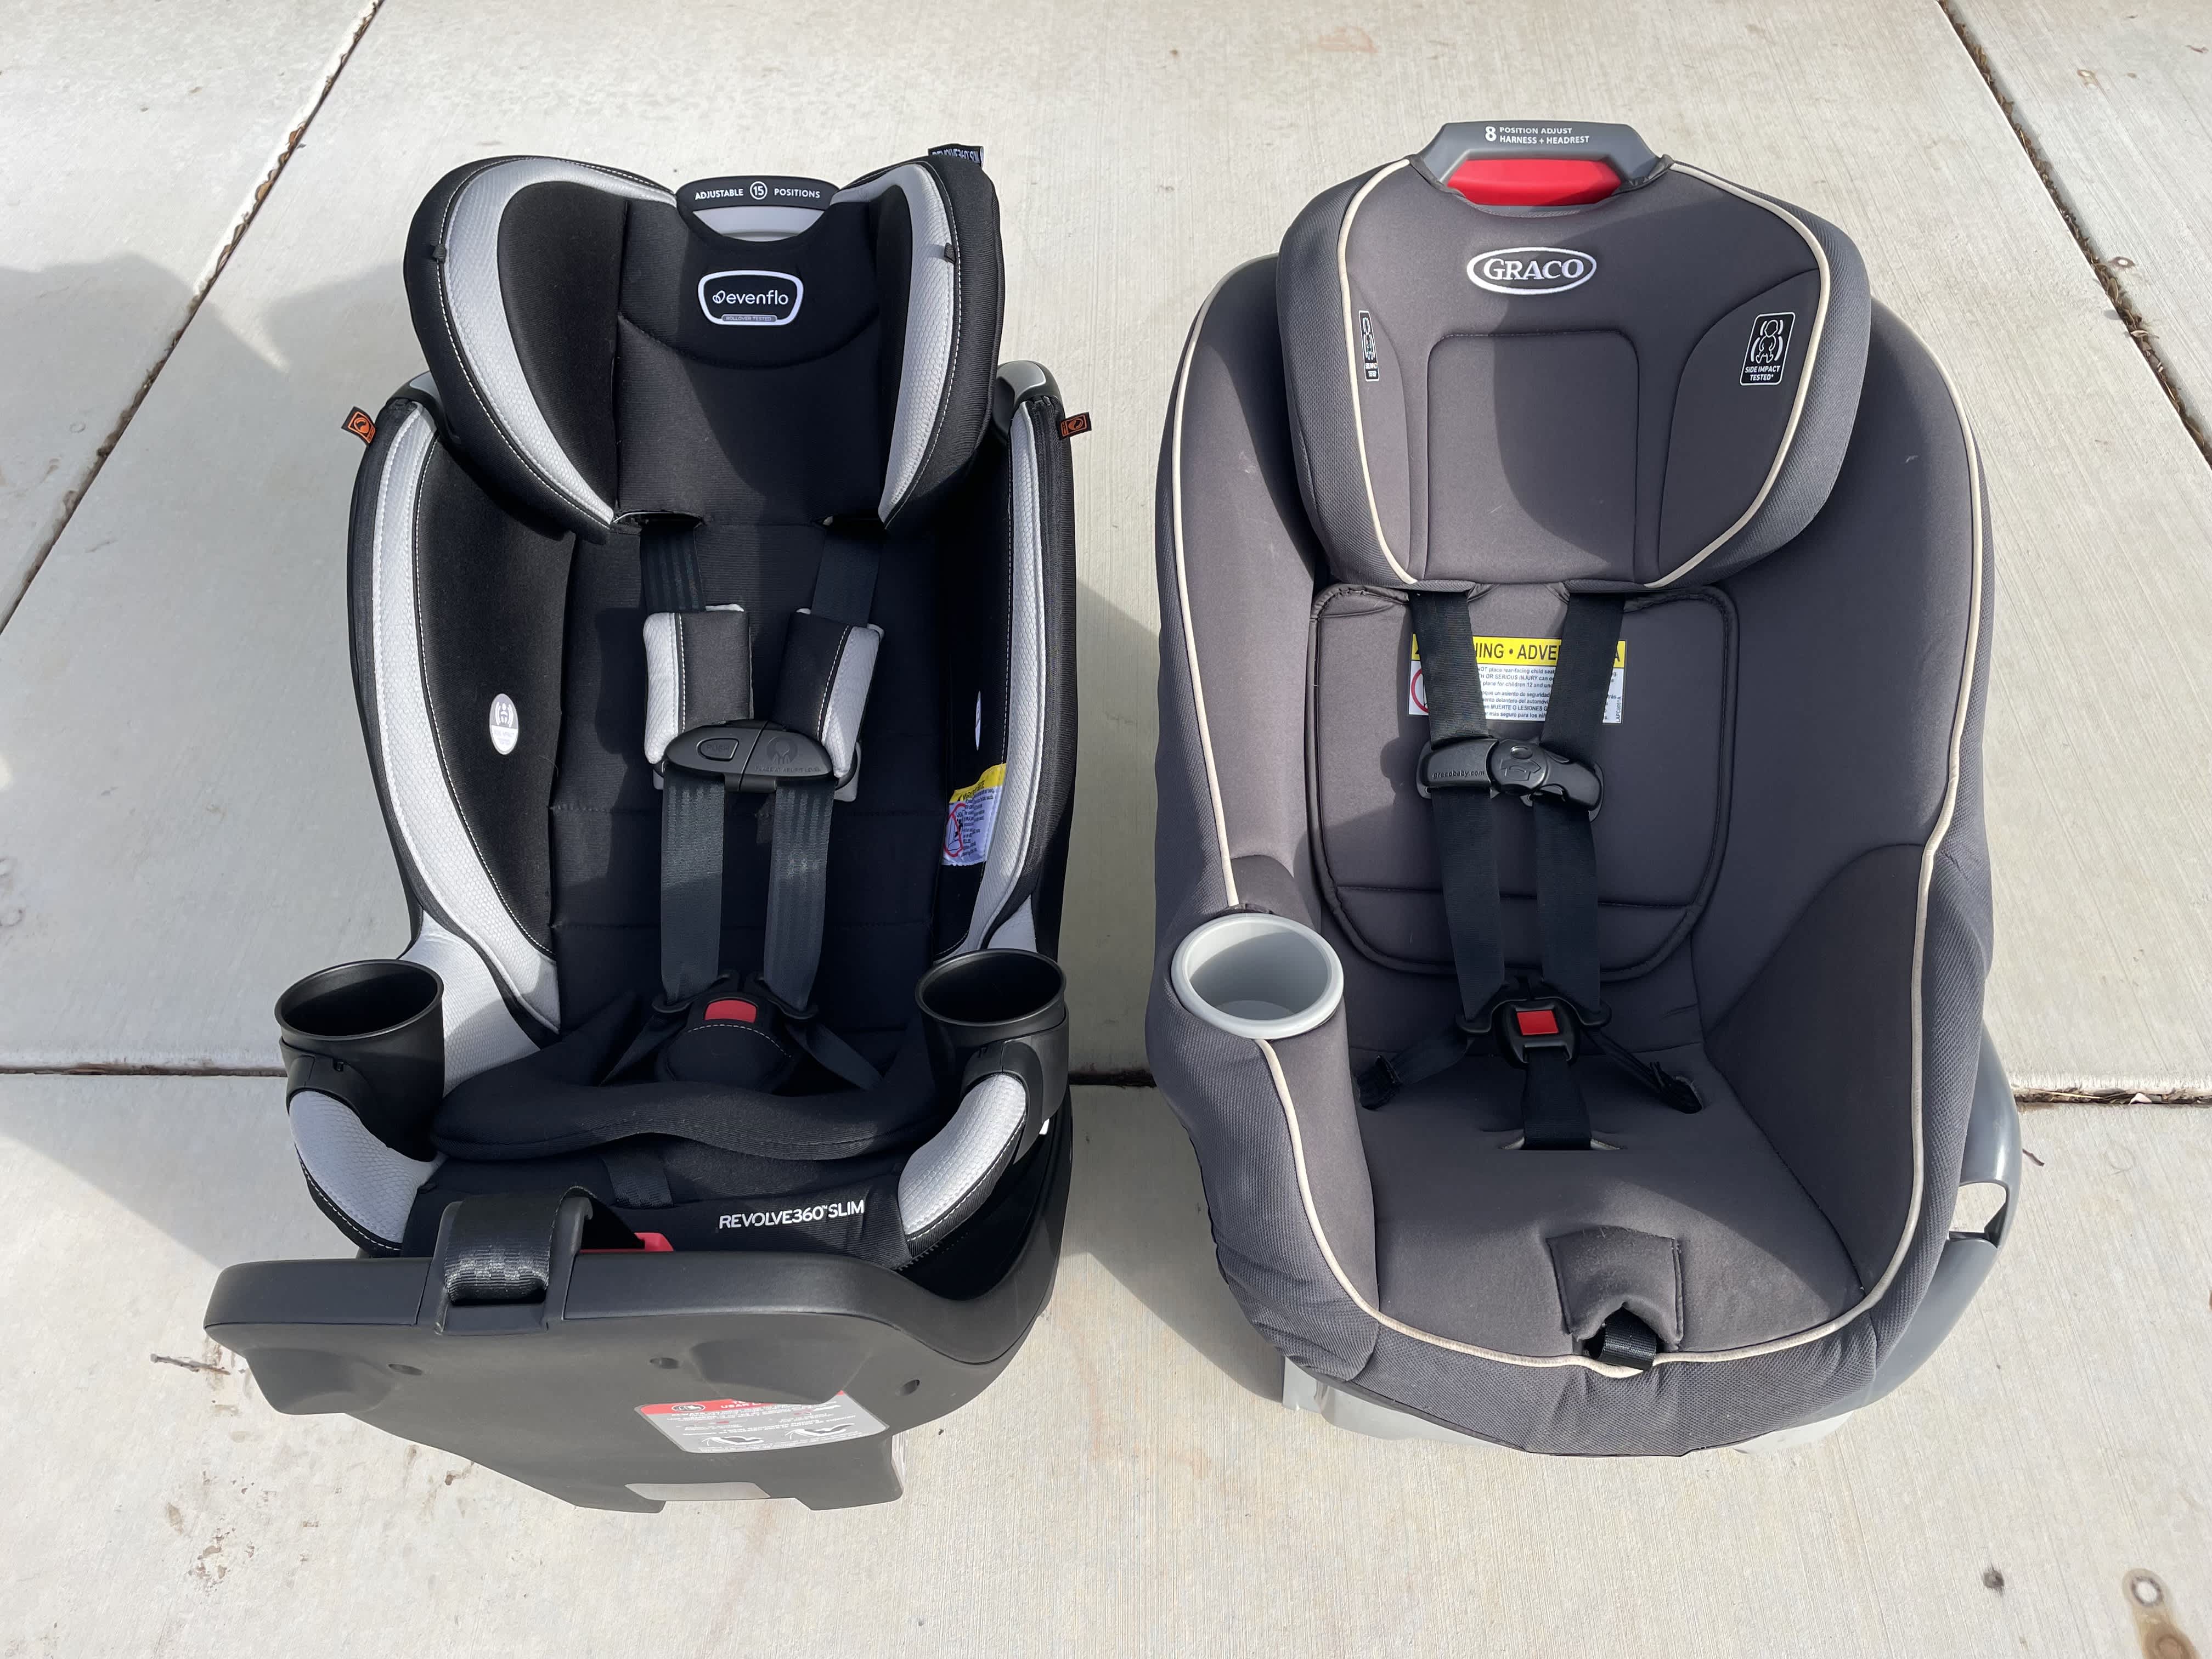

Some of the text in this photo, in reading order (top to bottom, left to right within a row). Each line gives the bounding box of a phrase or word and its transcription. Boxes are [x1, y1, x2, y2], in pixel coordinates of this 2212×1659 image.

[1485, 126, 1497, 142] 8
[1499, 135, 1537, 144] HARNESS
[1546, 135, 1590, 145] HEADREST
[695, 185, 820, 200] ADJUSTABLE 15 POSITIONS
[1483, 258, 1584, 281] GRACO
[726, 290, 789, 305] evenflo
[1516, 644, 1560, 661] ADVE
[828, 1199, 865, 1218] SLIM
